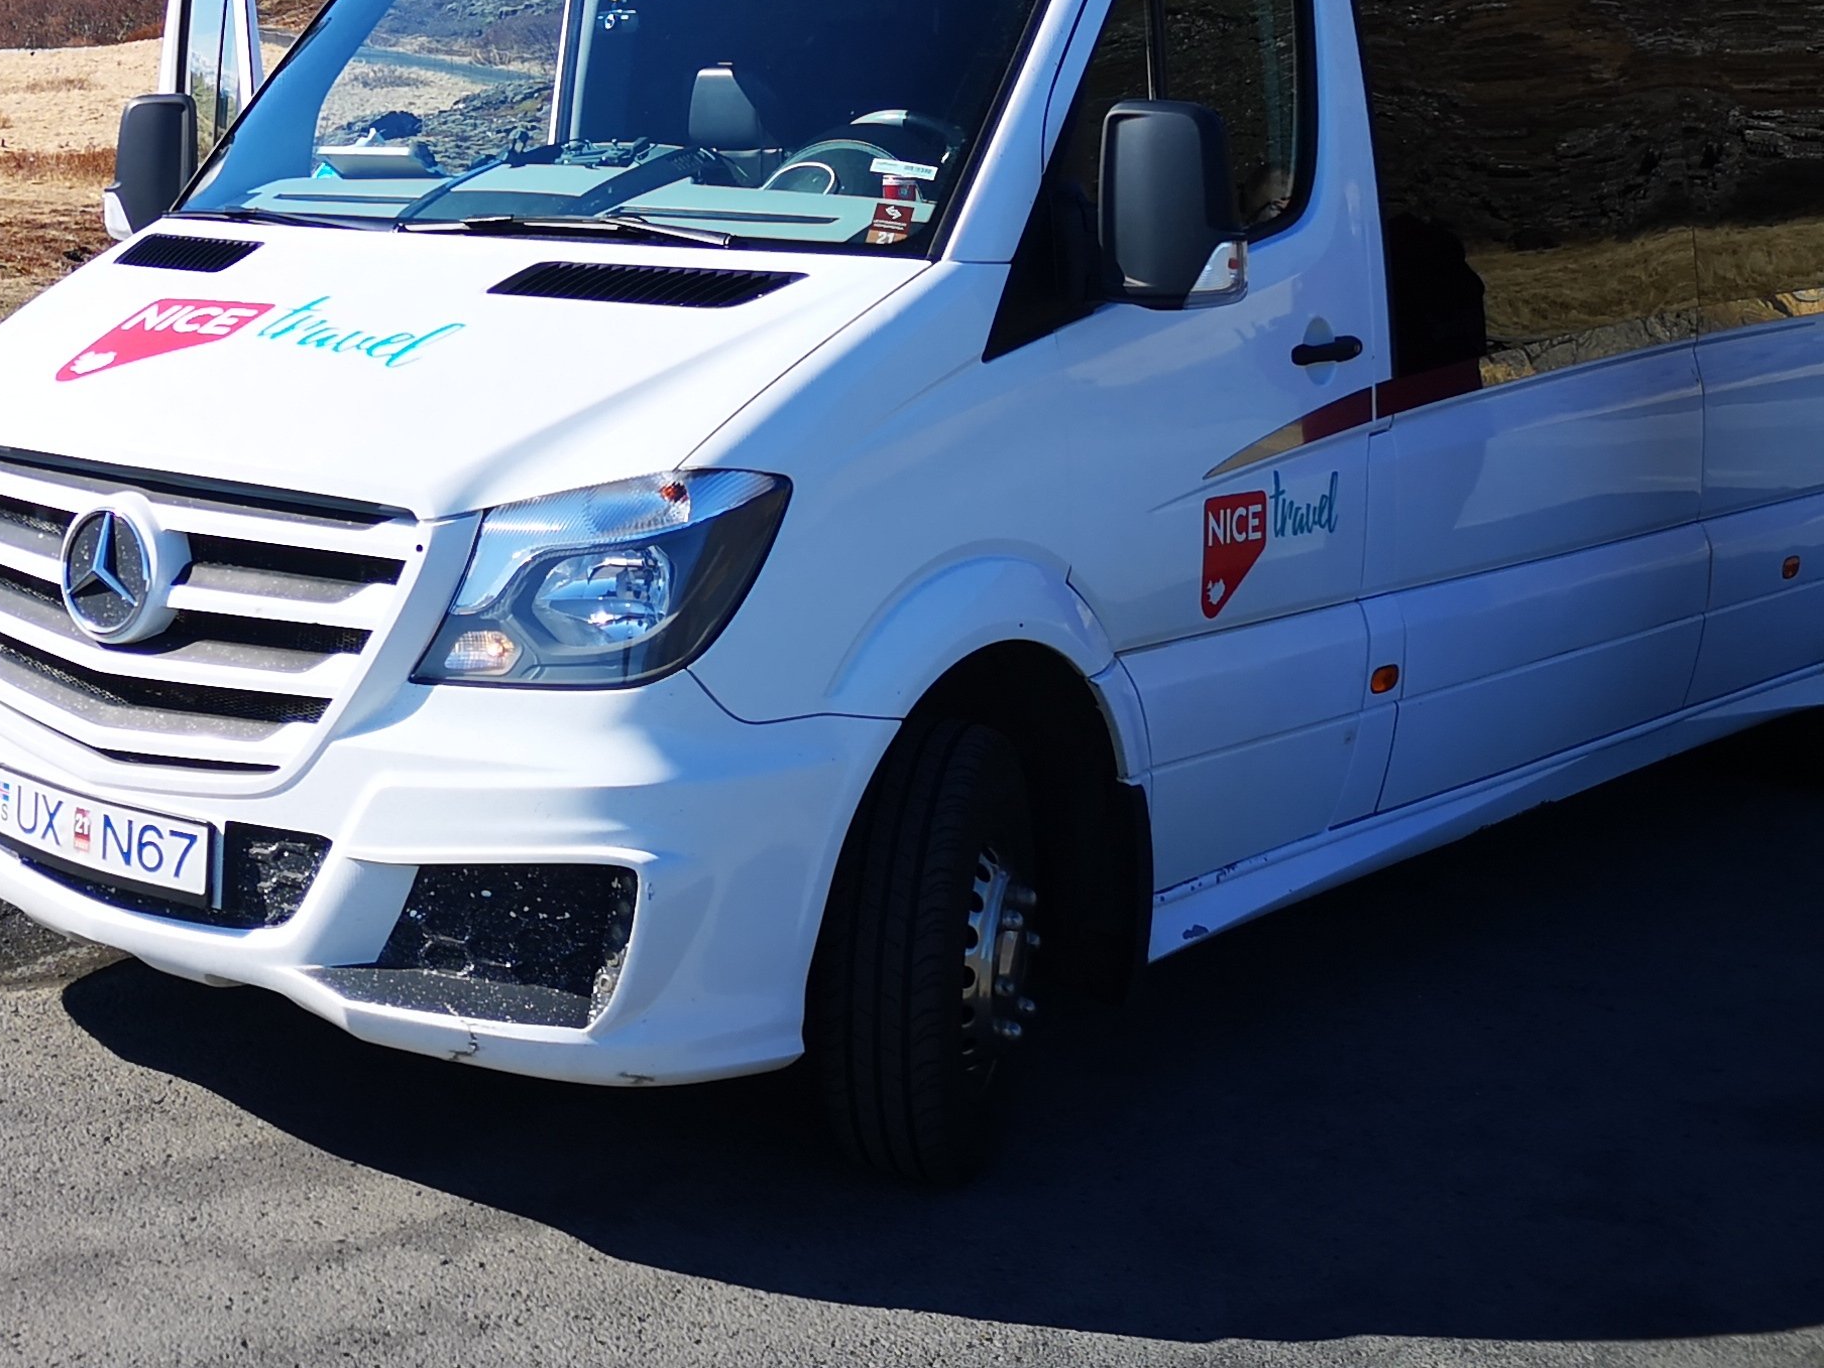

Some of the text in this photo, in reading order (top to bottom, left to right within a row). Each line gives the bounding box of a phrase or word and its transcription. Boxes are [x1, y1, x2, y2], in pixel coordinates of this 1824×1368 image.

[876, 231, 895, 244] 21
[120, 295, 467, 368] NICE travel
[1207, 469, 1339, 547] NICE travel
[16, 784, 198, 879] UX N67
[74, 813, 91, 835] 21
